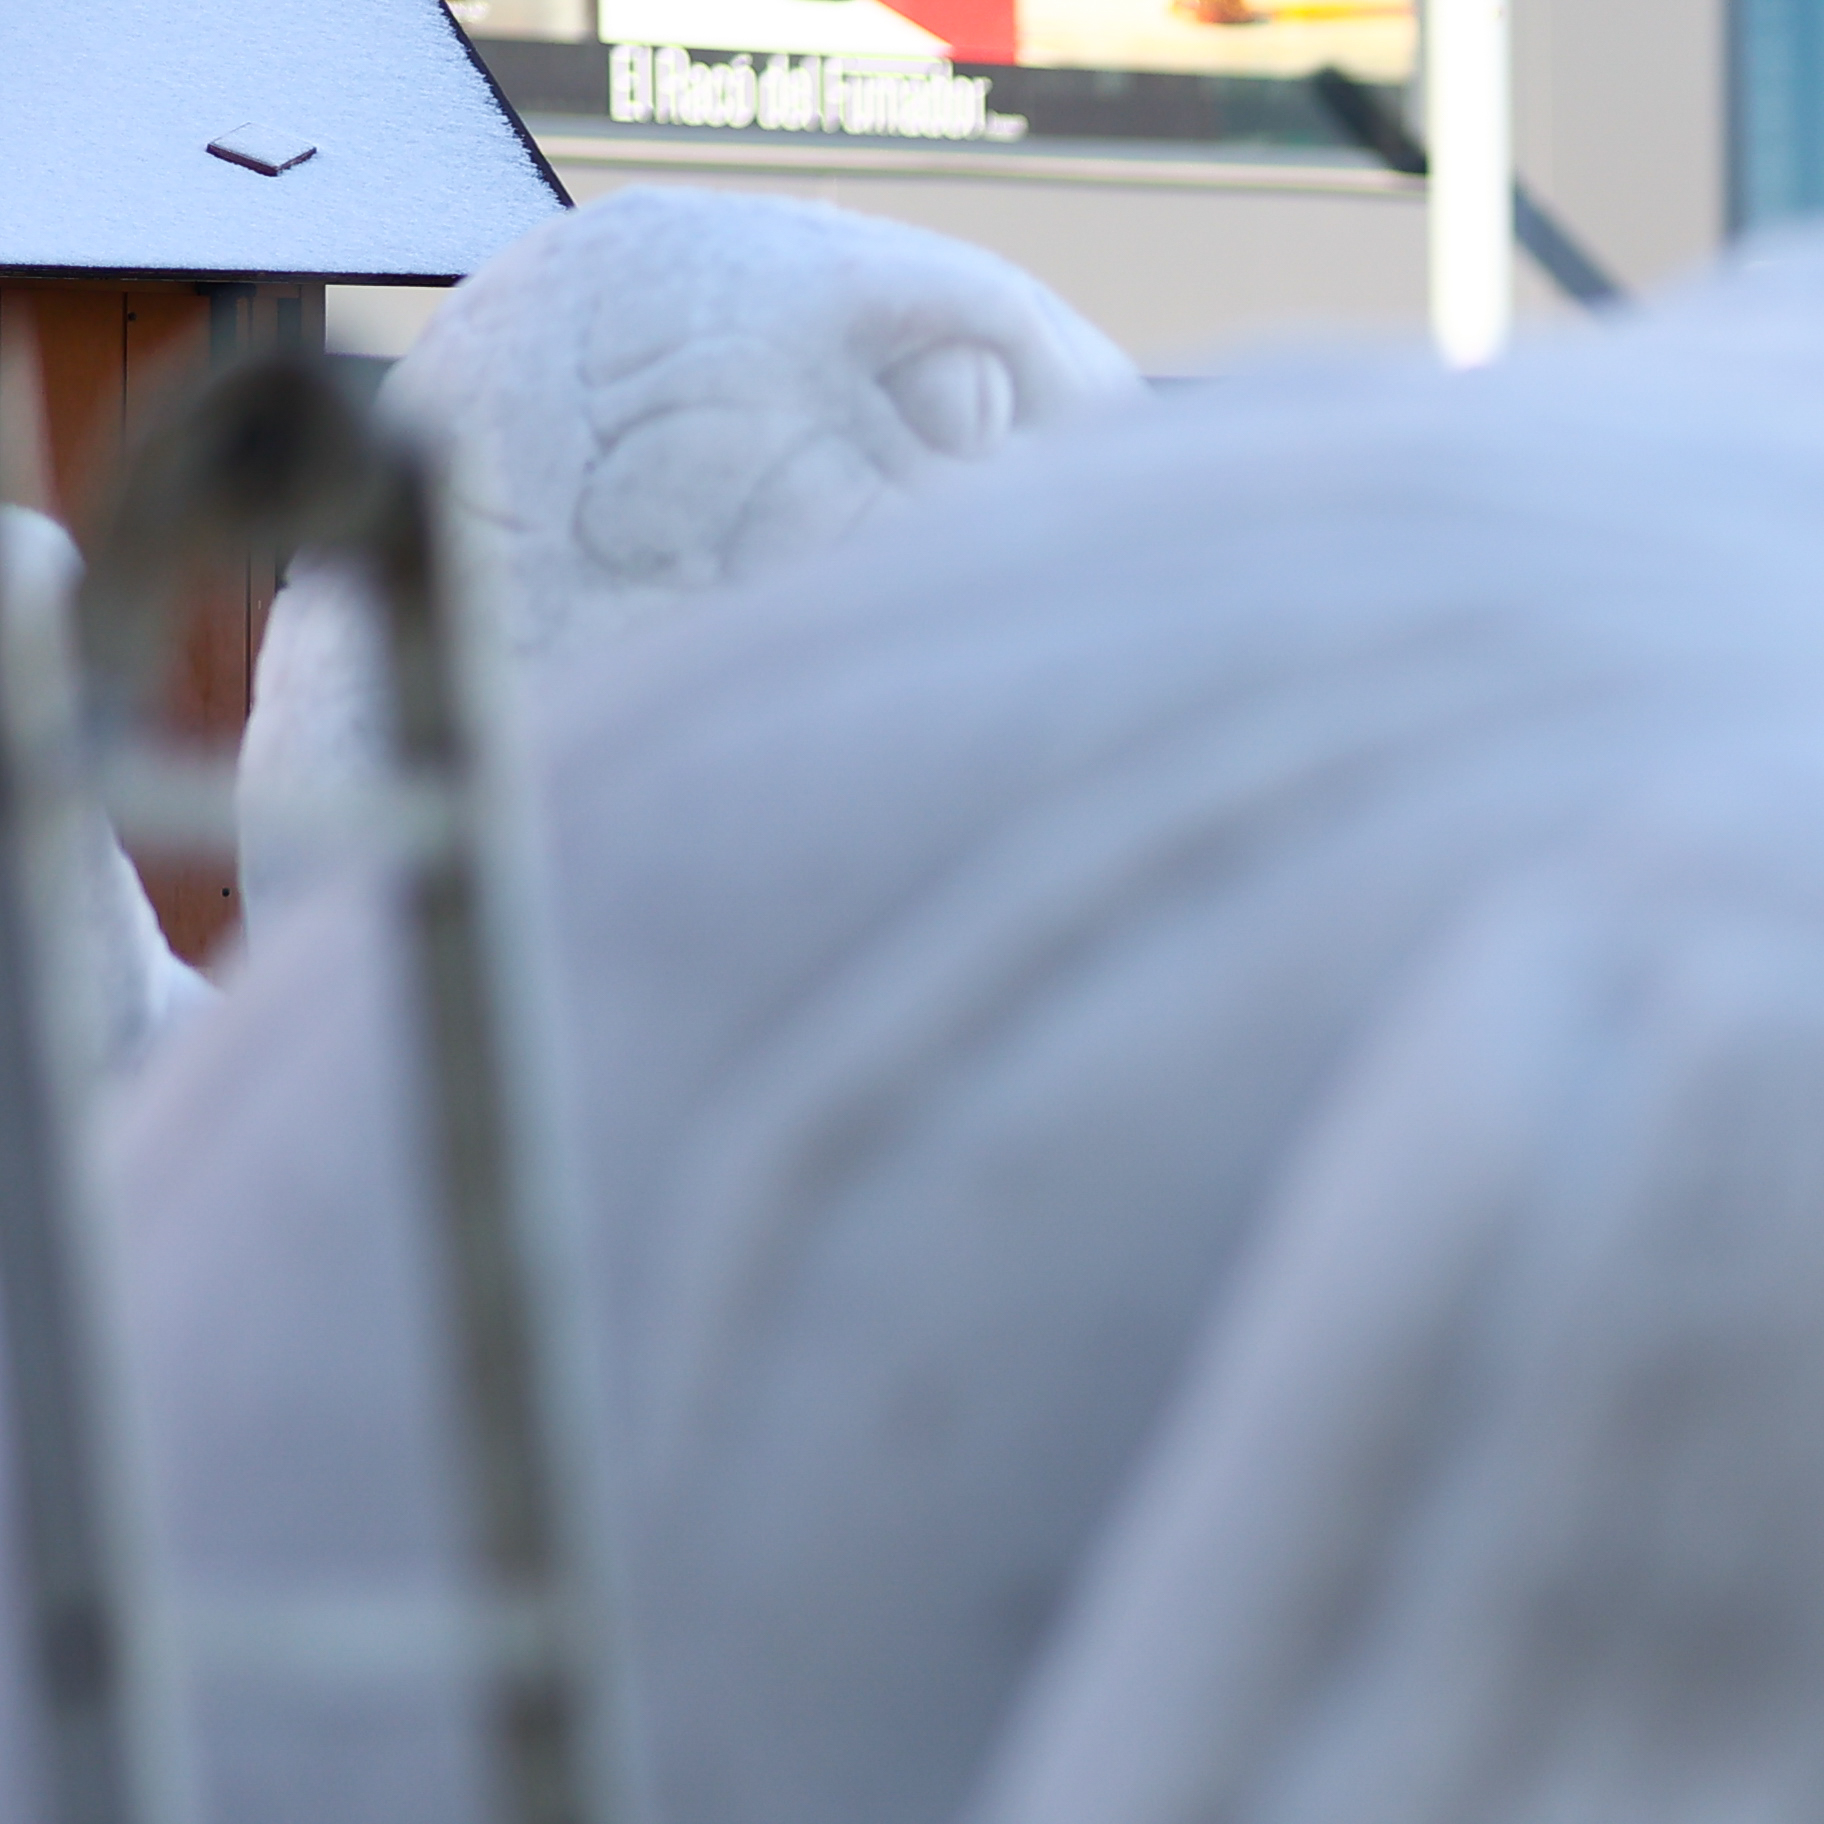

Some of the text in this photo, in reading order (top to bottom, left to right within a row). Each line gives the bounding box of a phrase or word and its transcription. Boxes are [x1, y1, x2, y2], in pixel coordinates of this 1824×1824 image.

[609, 44, 993, 141] El Racó del Fumador
